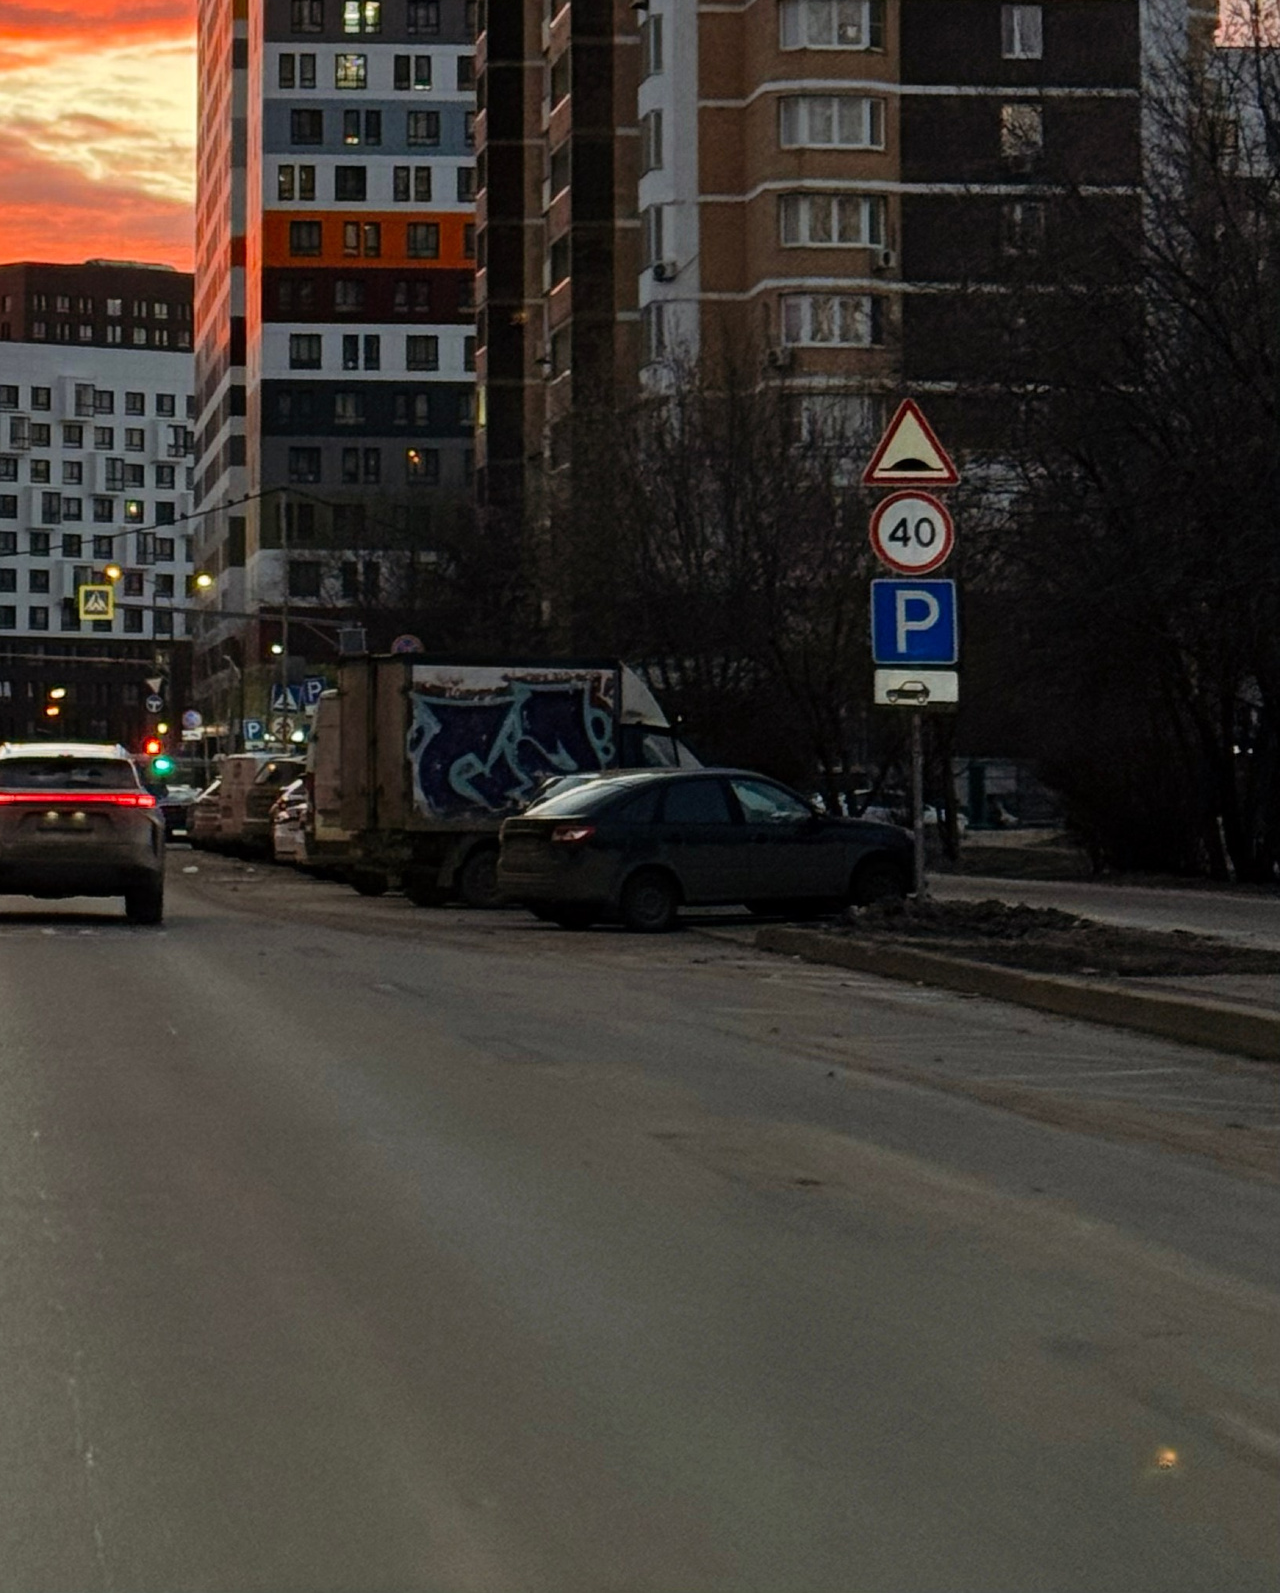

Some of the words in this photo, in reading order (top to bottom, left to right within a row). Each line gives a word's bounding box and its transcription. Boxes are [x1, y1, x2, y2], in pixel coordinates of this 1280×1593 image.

[888, 517, 936, 548] 40
[895, 590, 940, 653] P
[308, 681, 322, 702] P
[248, 722, 261, 739] P
